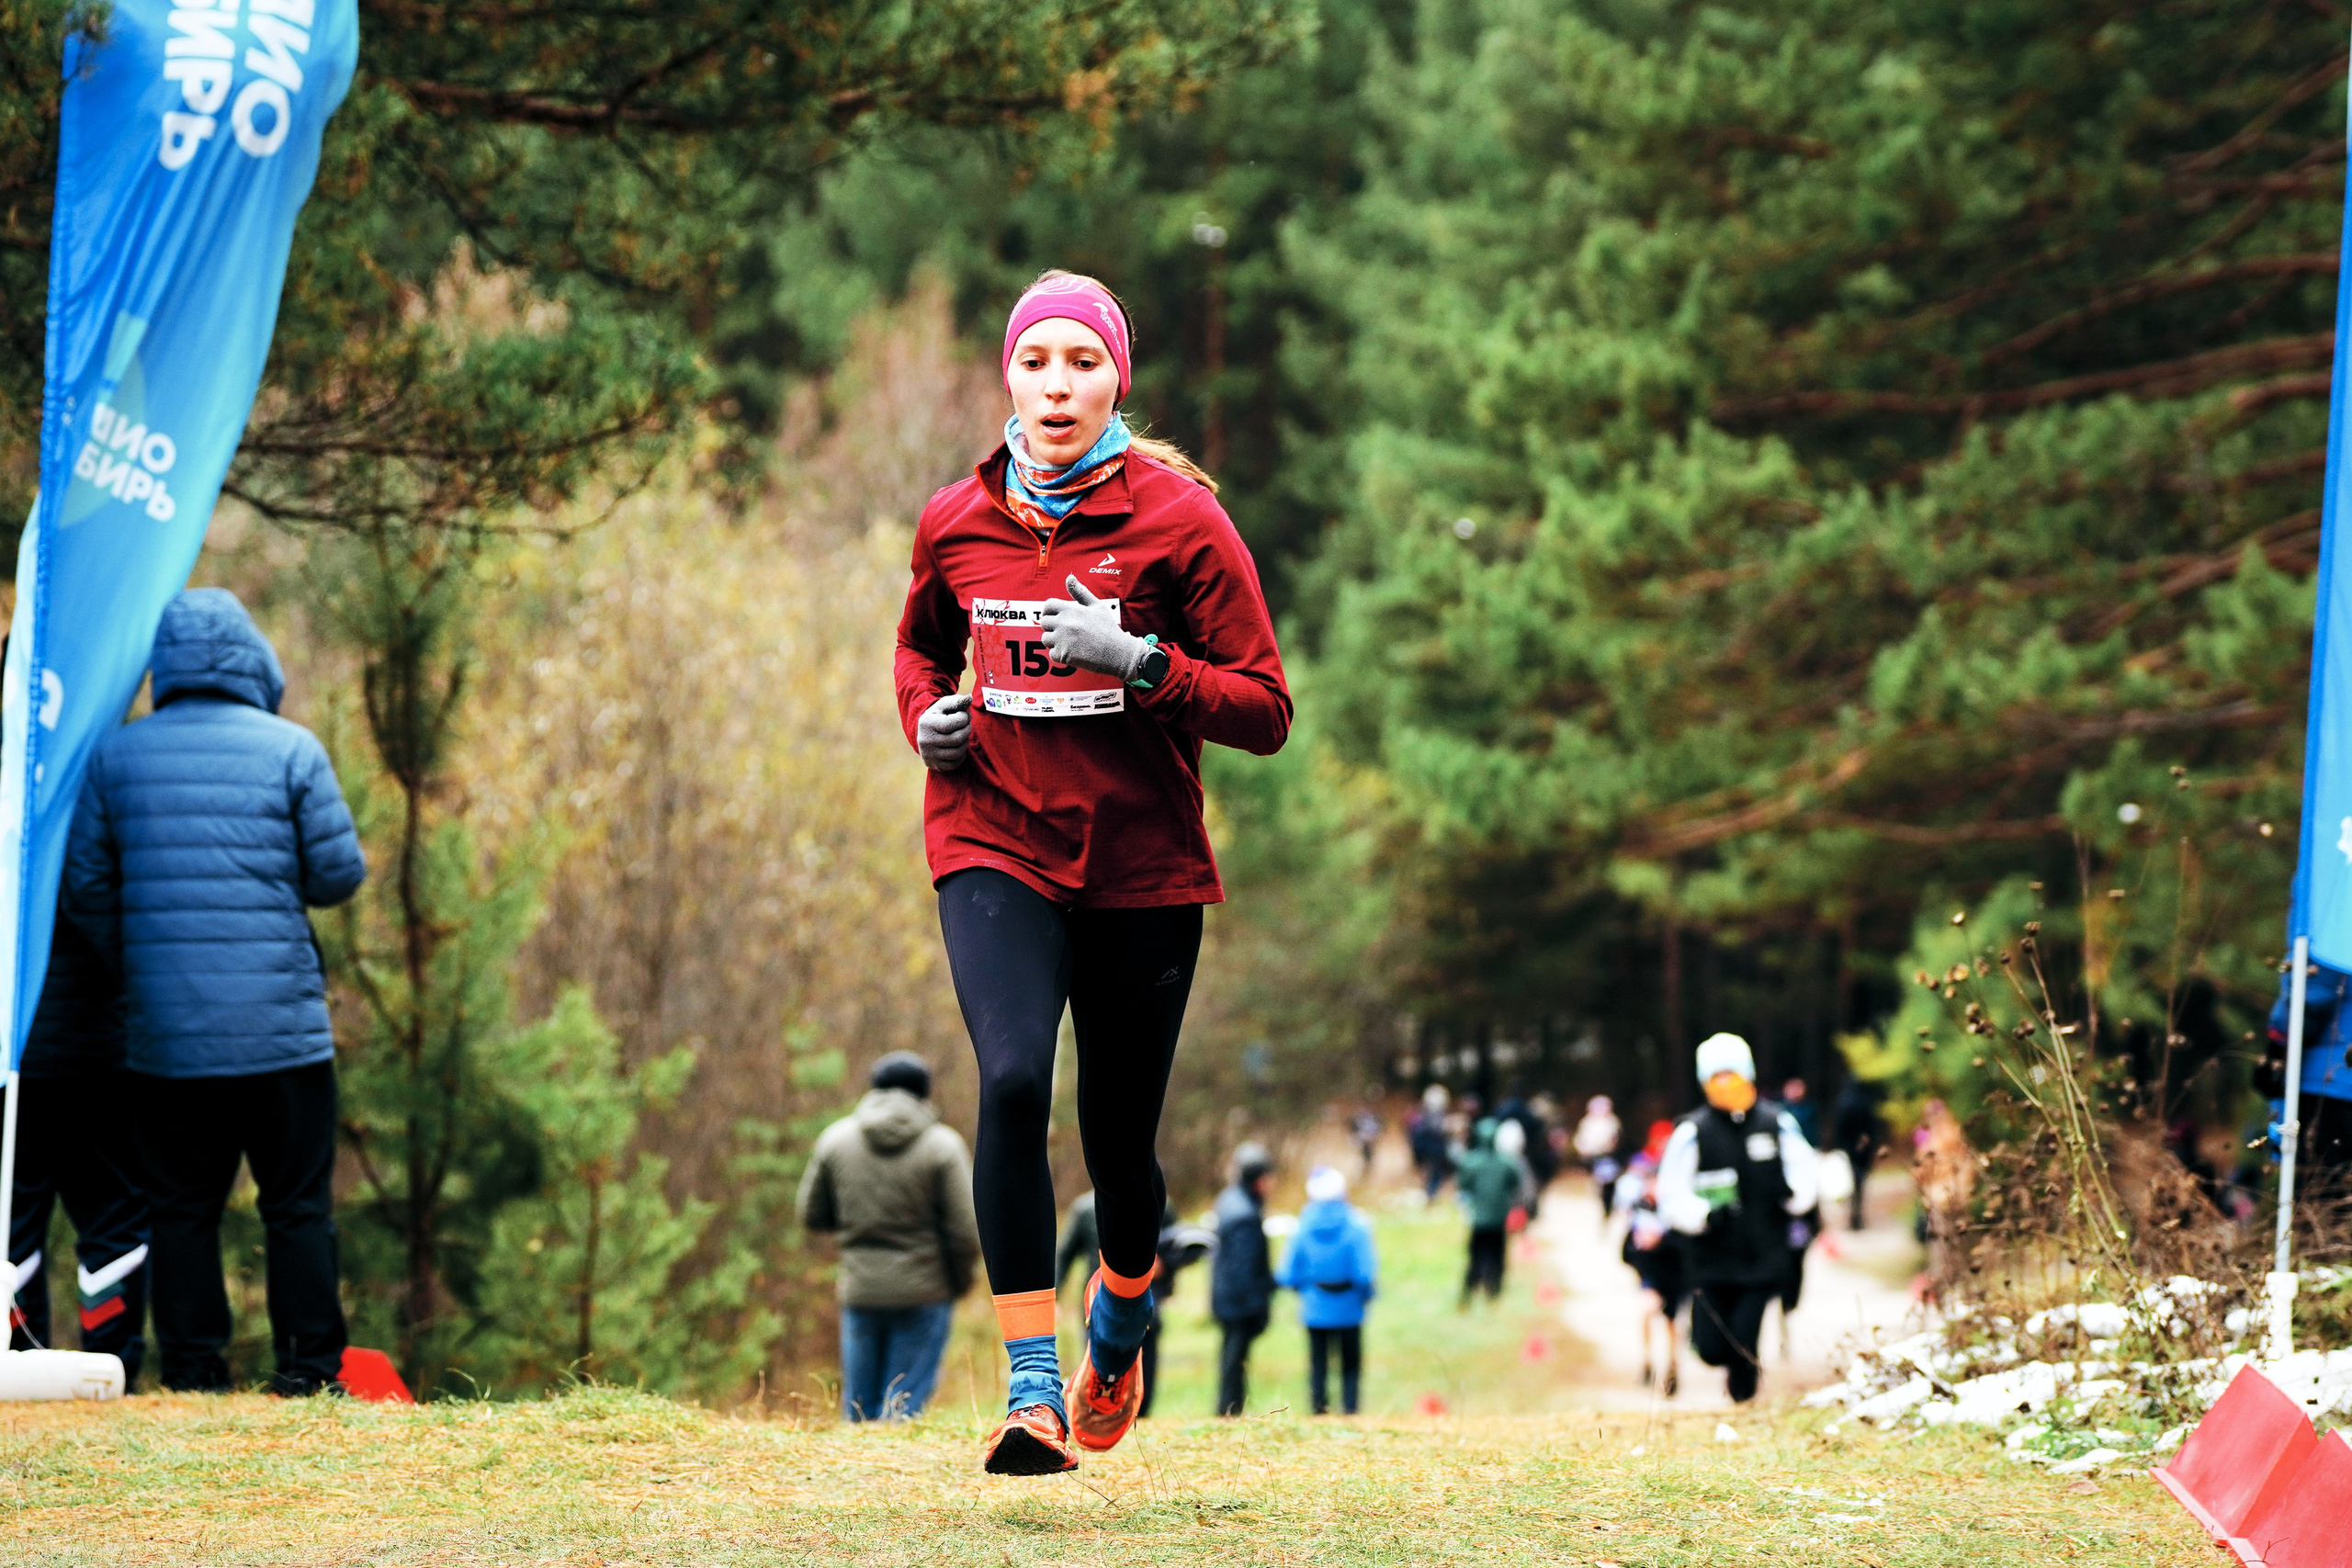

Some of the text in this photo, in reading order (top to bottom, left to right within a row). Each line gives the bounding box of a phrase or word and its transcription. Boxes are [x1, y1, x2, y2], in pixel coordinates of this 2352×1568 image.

[158, 0, 239, 171] ИРЬ
[1089, 567, 1123, 576] DEMIX
[977, 608, 1027, 621] КЛЮКВА
